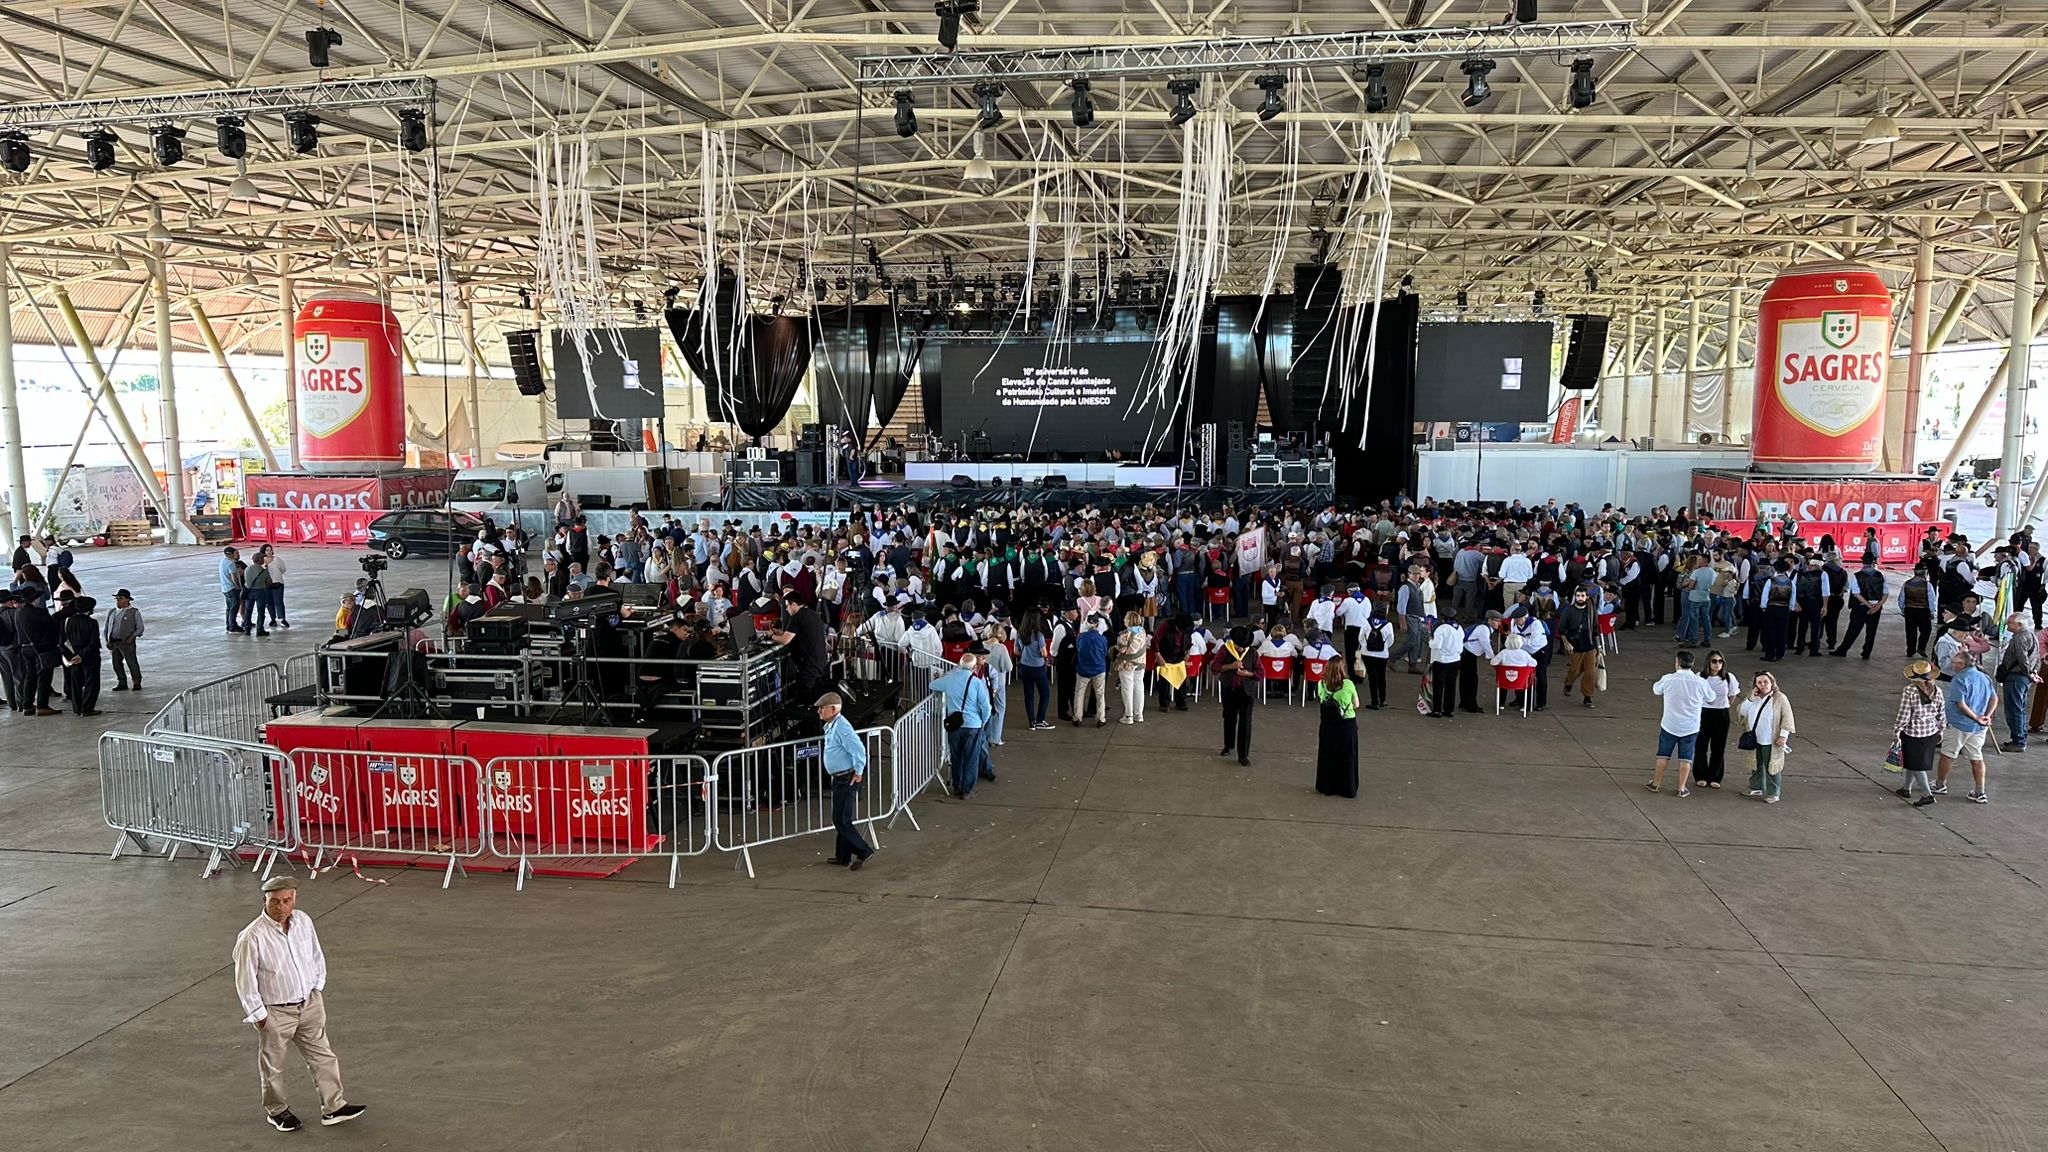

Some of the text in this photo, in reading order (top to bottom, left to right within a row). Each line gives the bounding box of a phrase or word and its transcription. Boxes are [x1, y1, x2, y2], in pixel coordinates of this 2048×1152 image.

[1035, 366, 1078, 376] aniversário
[1079, 367, 1089, 375] da
[1783, 352, 1882, 384] SAGRES
[301, 367, 362, 393] AGRES
[1002, 377, 1111, 387] Elevação do Cante Alentejano
[1044, 387, 1075, 396] Cultural
[1083, 387, 1117, 396] Imaterial
[1002, 397, 1111, 407] da Humanidade pela UNESCO
[99, 485, 127, 494] BLACK
[250, 526, 267, 535] SAGRES
[275, 527, 292, 535] SAGRES
[325, 527, 342, 536] SAGRES
[350, 528, 367, 537] SAGRES
[1883, 546, 1907, 554] SAGRES
[296, 781, 340, 813] AGRES
[384, 787, 438, 808] SAGRES
[572, 796, 630, 818] SAGRES
